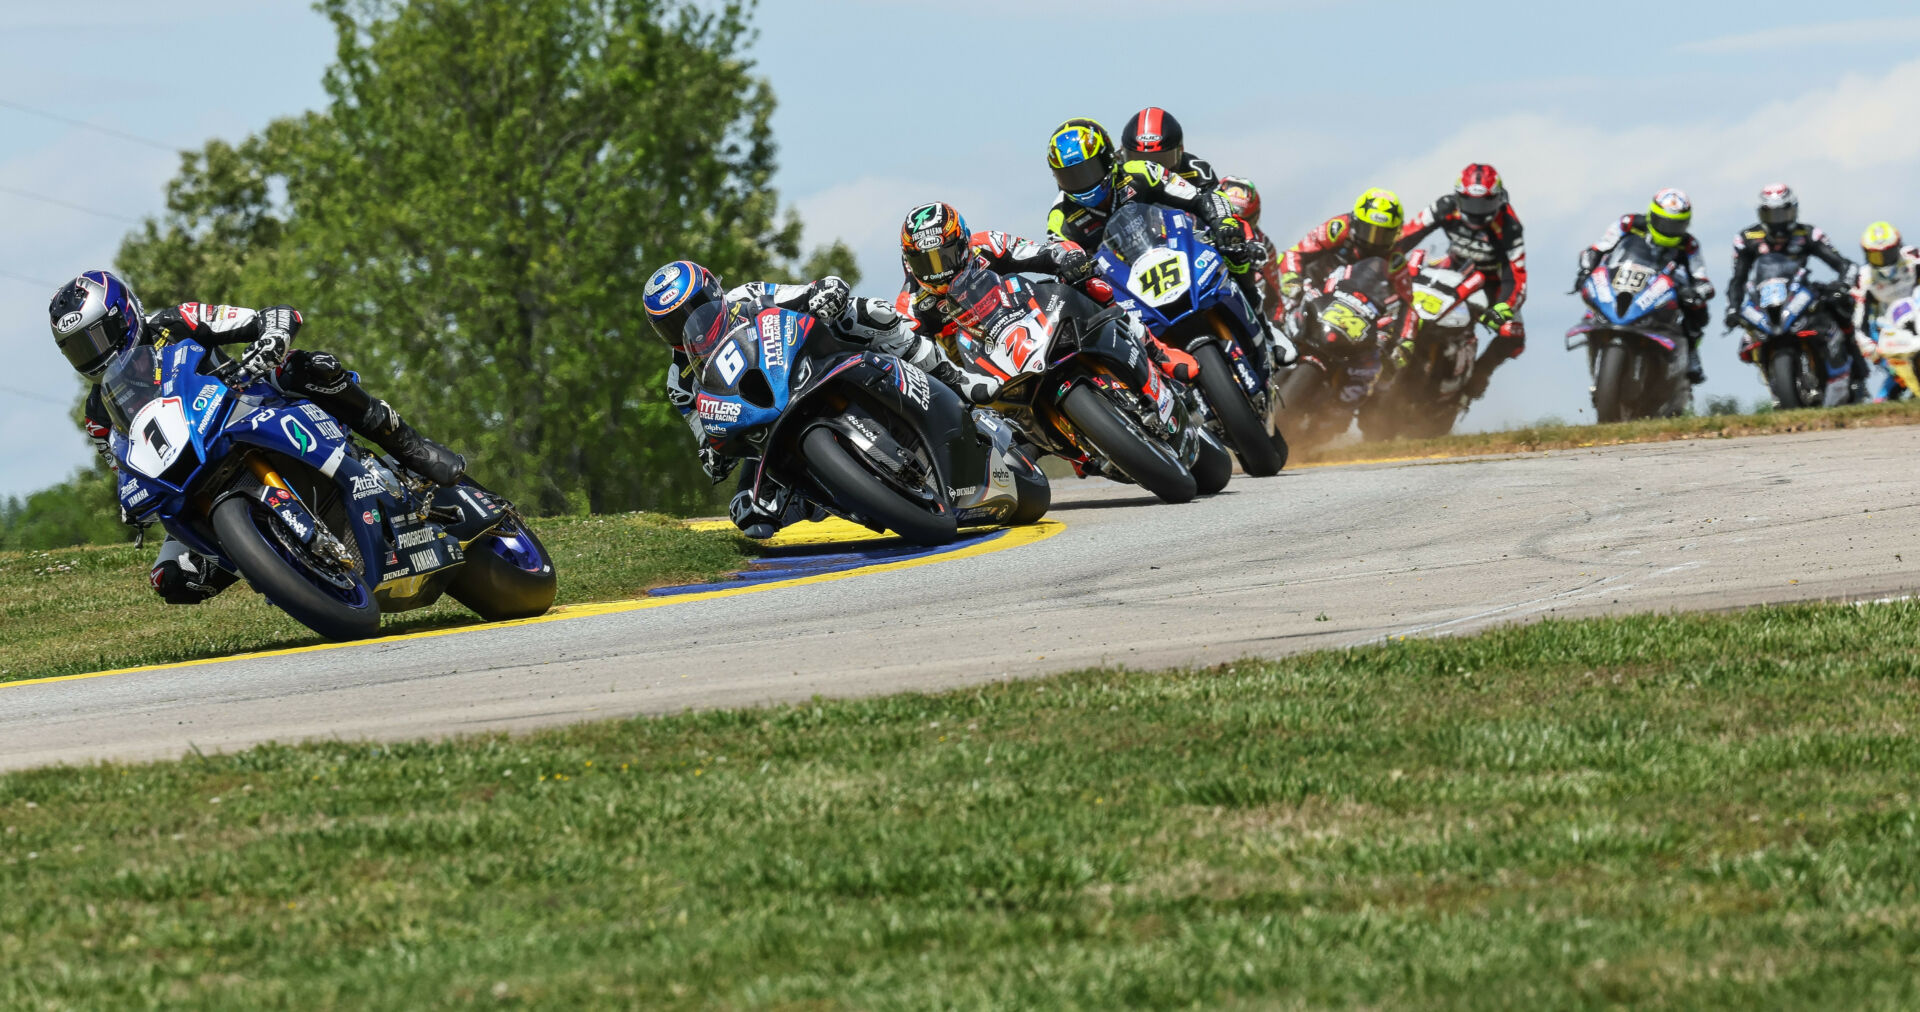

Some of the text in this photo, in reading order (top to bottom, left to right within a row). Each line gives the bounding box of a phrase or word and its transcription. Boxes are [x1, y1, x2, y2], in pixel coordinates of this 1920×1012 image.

[1138, 256, 1184, 299] 45
[61, 314, 80, 329] Arai
[783, 315, 792, 345] alpha
[988, 314, 1009, 338] MOUNT
[1322, 302, 1368, 339] 24
[761, 314, 774, 369] TYTLERS
[772, 314, 783, 366] CYCLE RACING
[1003, 326, 1035, 374] 2
[715, 339, 746, 388] 6
[699, 412, 739, 423] CYCLE RACING
[700, 399, 742, 416] TYTLERS
[143, 416, 171, 459] 1
[705, 424, 727, 433] alpha
[992, 470, 1009, 482] alpha
[457, 488, 489, 519] 1
[956, 485, 977, 497] DUNLOP
[397, 526, 436, 550] PROGRESSIVE
[409, 547, 441, 573] YAMAHA
[382, 566, 410, 581] DUNLOP
